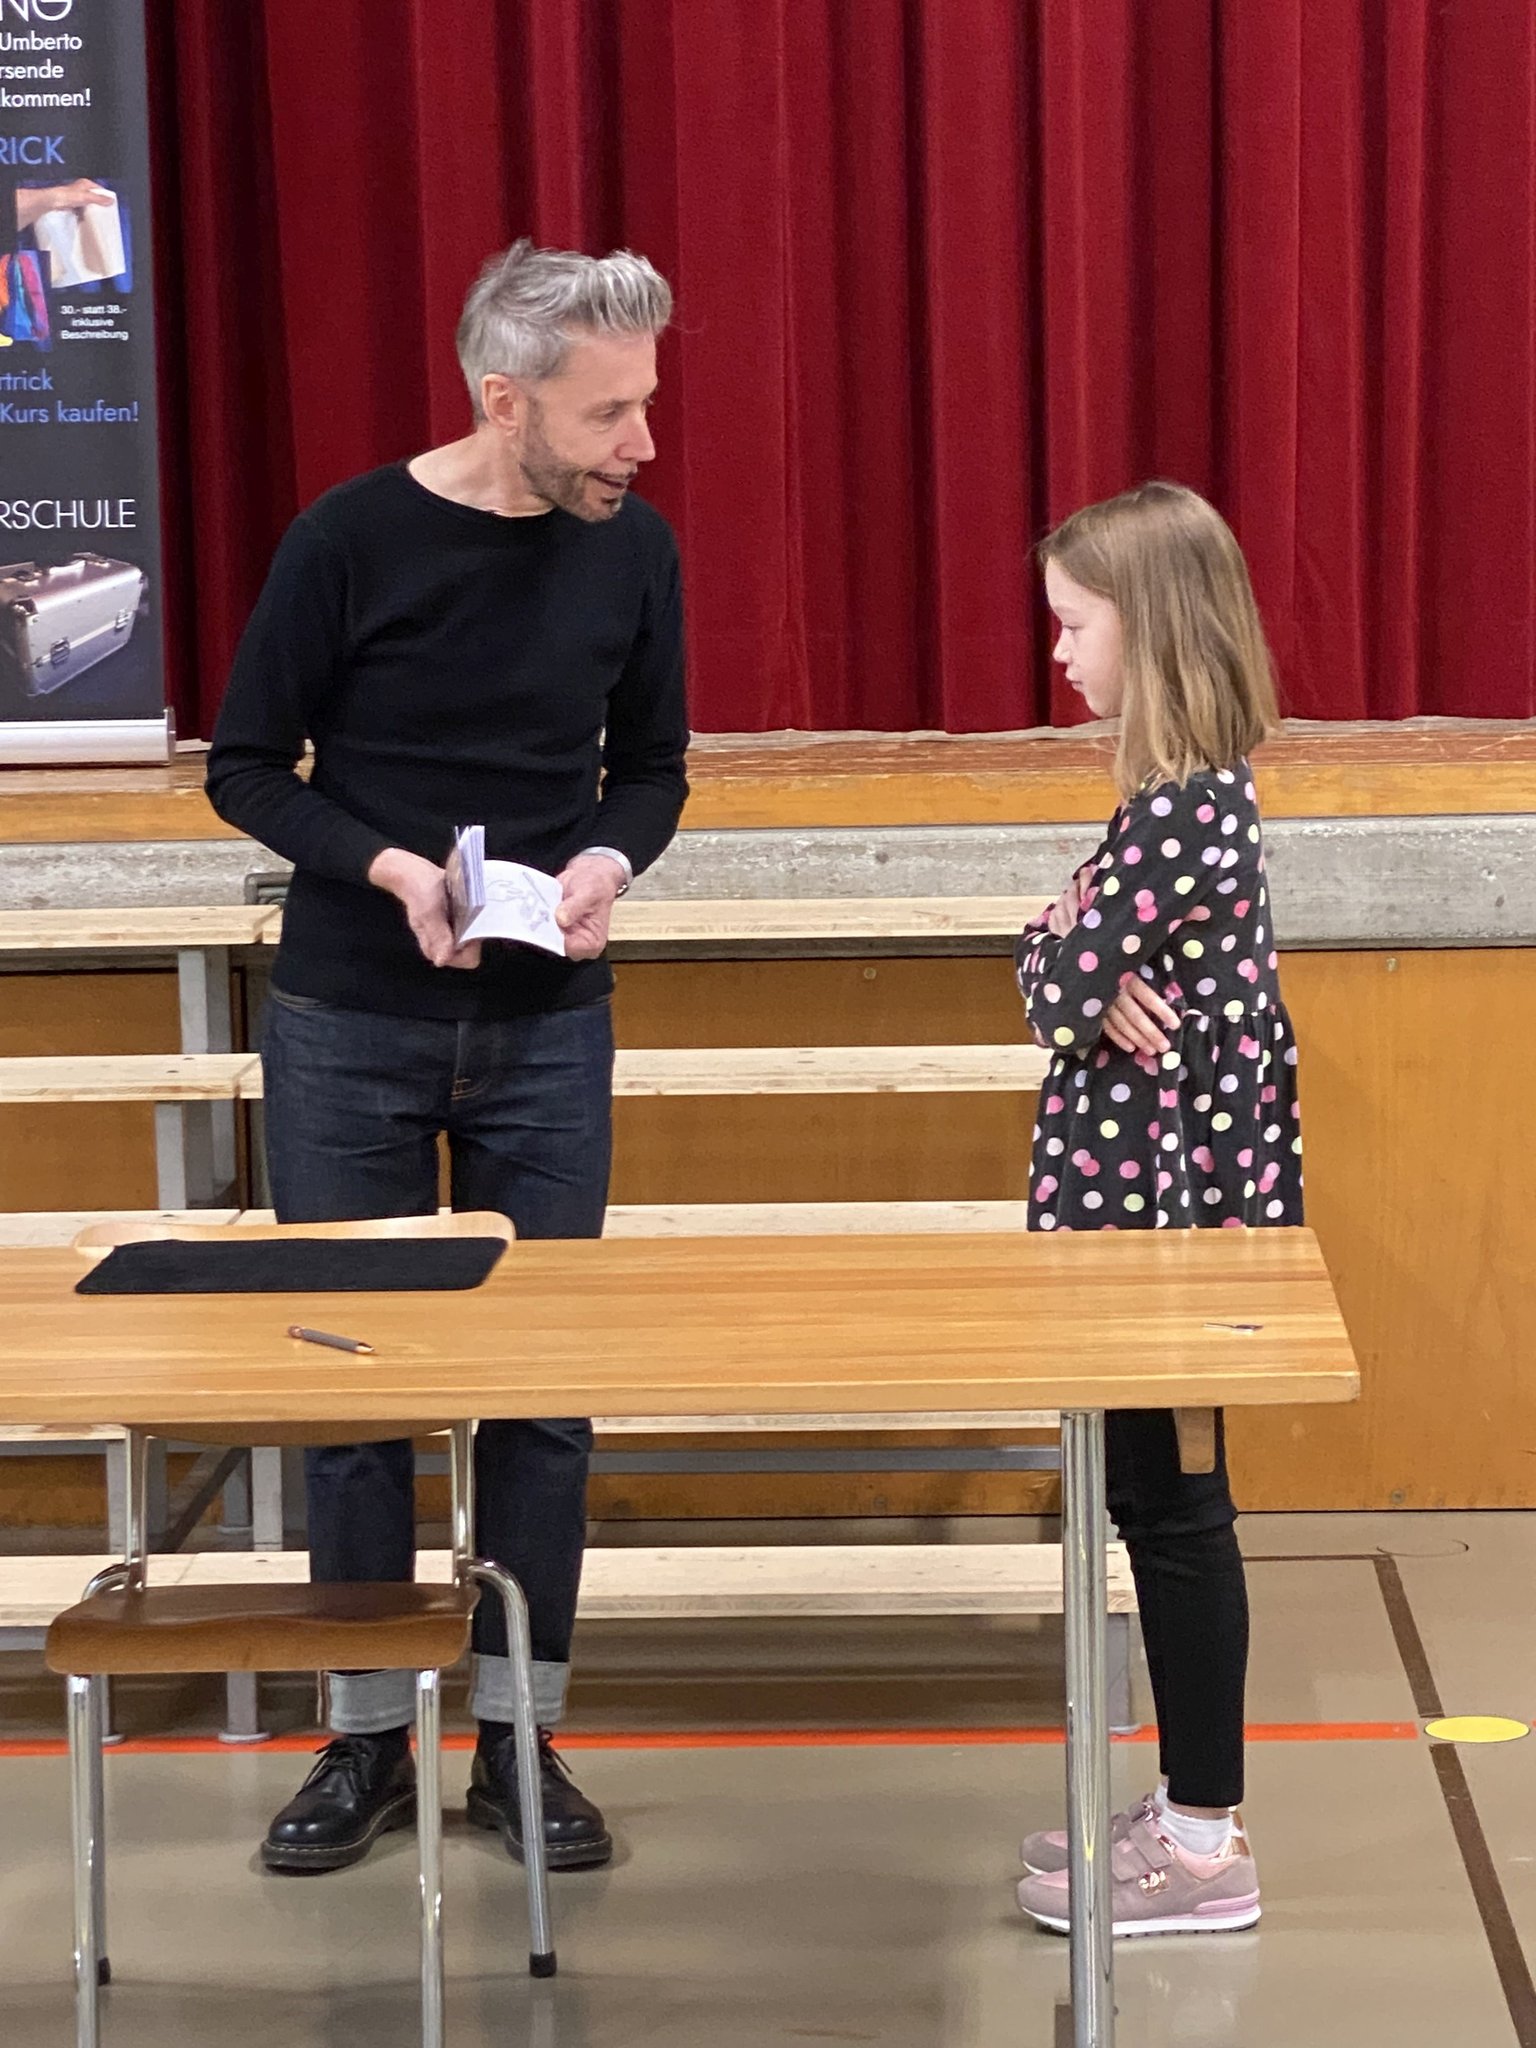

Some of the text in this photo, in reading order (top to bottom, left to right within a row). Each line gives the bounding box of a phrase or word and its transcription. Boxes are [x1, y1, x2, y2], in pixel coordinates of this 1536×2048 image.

[0, 30, 82, 51] Umberto
[0, 58, 64, 79] rsende
[1, 87, 91, 107] kommen!
[0, 136, 65, 165] RICK
[61, 330, 129, 341] Beschreibung
[0, 399, 139, 423] Kurs kaufen!
[0, 499, 136, 528] RSCHULE
